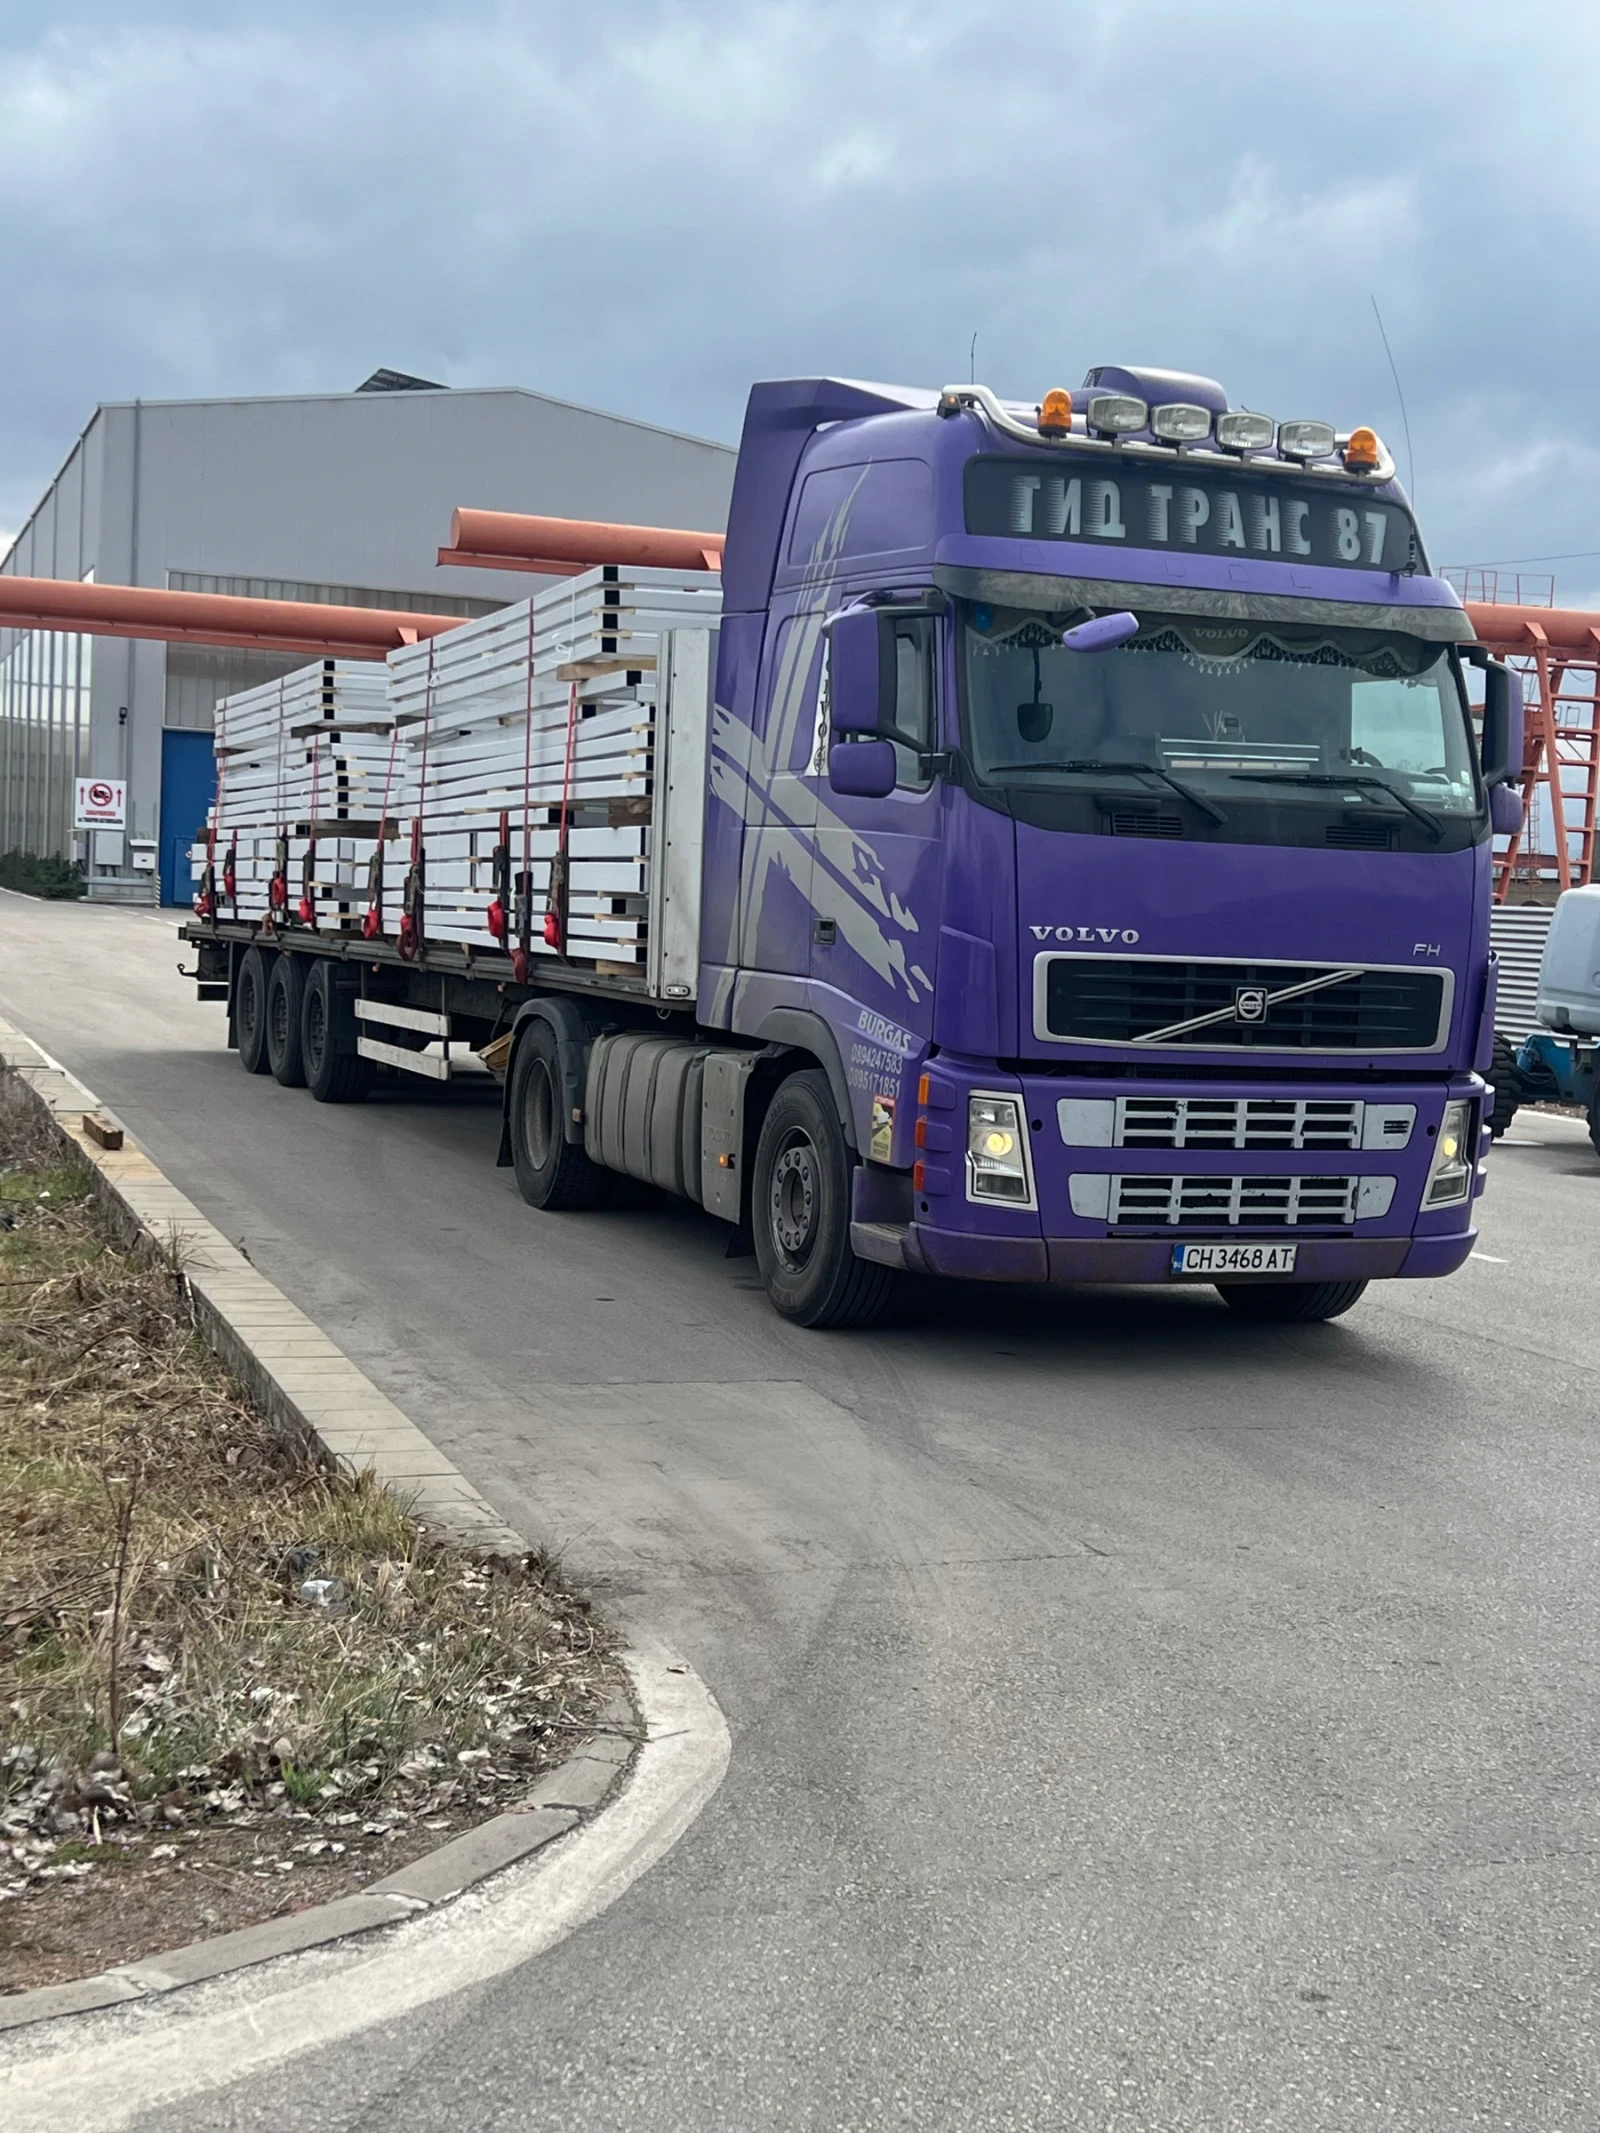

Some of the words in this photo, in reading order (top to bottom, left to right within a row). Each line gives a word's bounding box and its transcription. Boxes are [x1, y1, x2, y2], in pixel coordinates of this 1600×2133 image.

[1009, 476, 1126, 539] ГИД
[1147, 484, 1312, 556] ТРАНС
[1331, 508, 1388, 565] 87
[1193, 628, 1249, 639] VOLVO
[1030, 926, 1140, 944] VOLVO
[1413, 943, 1441, 957] FH
[858, 1010, 912, 1052] BURGAS
[851, 1043, 903, 1075] 0894247583
[847, 1066, 901, 1100] 0895171851
